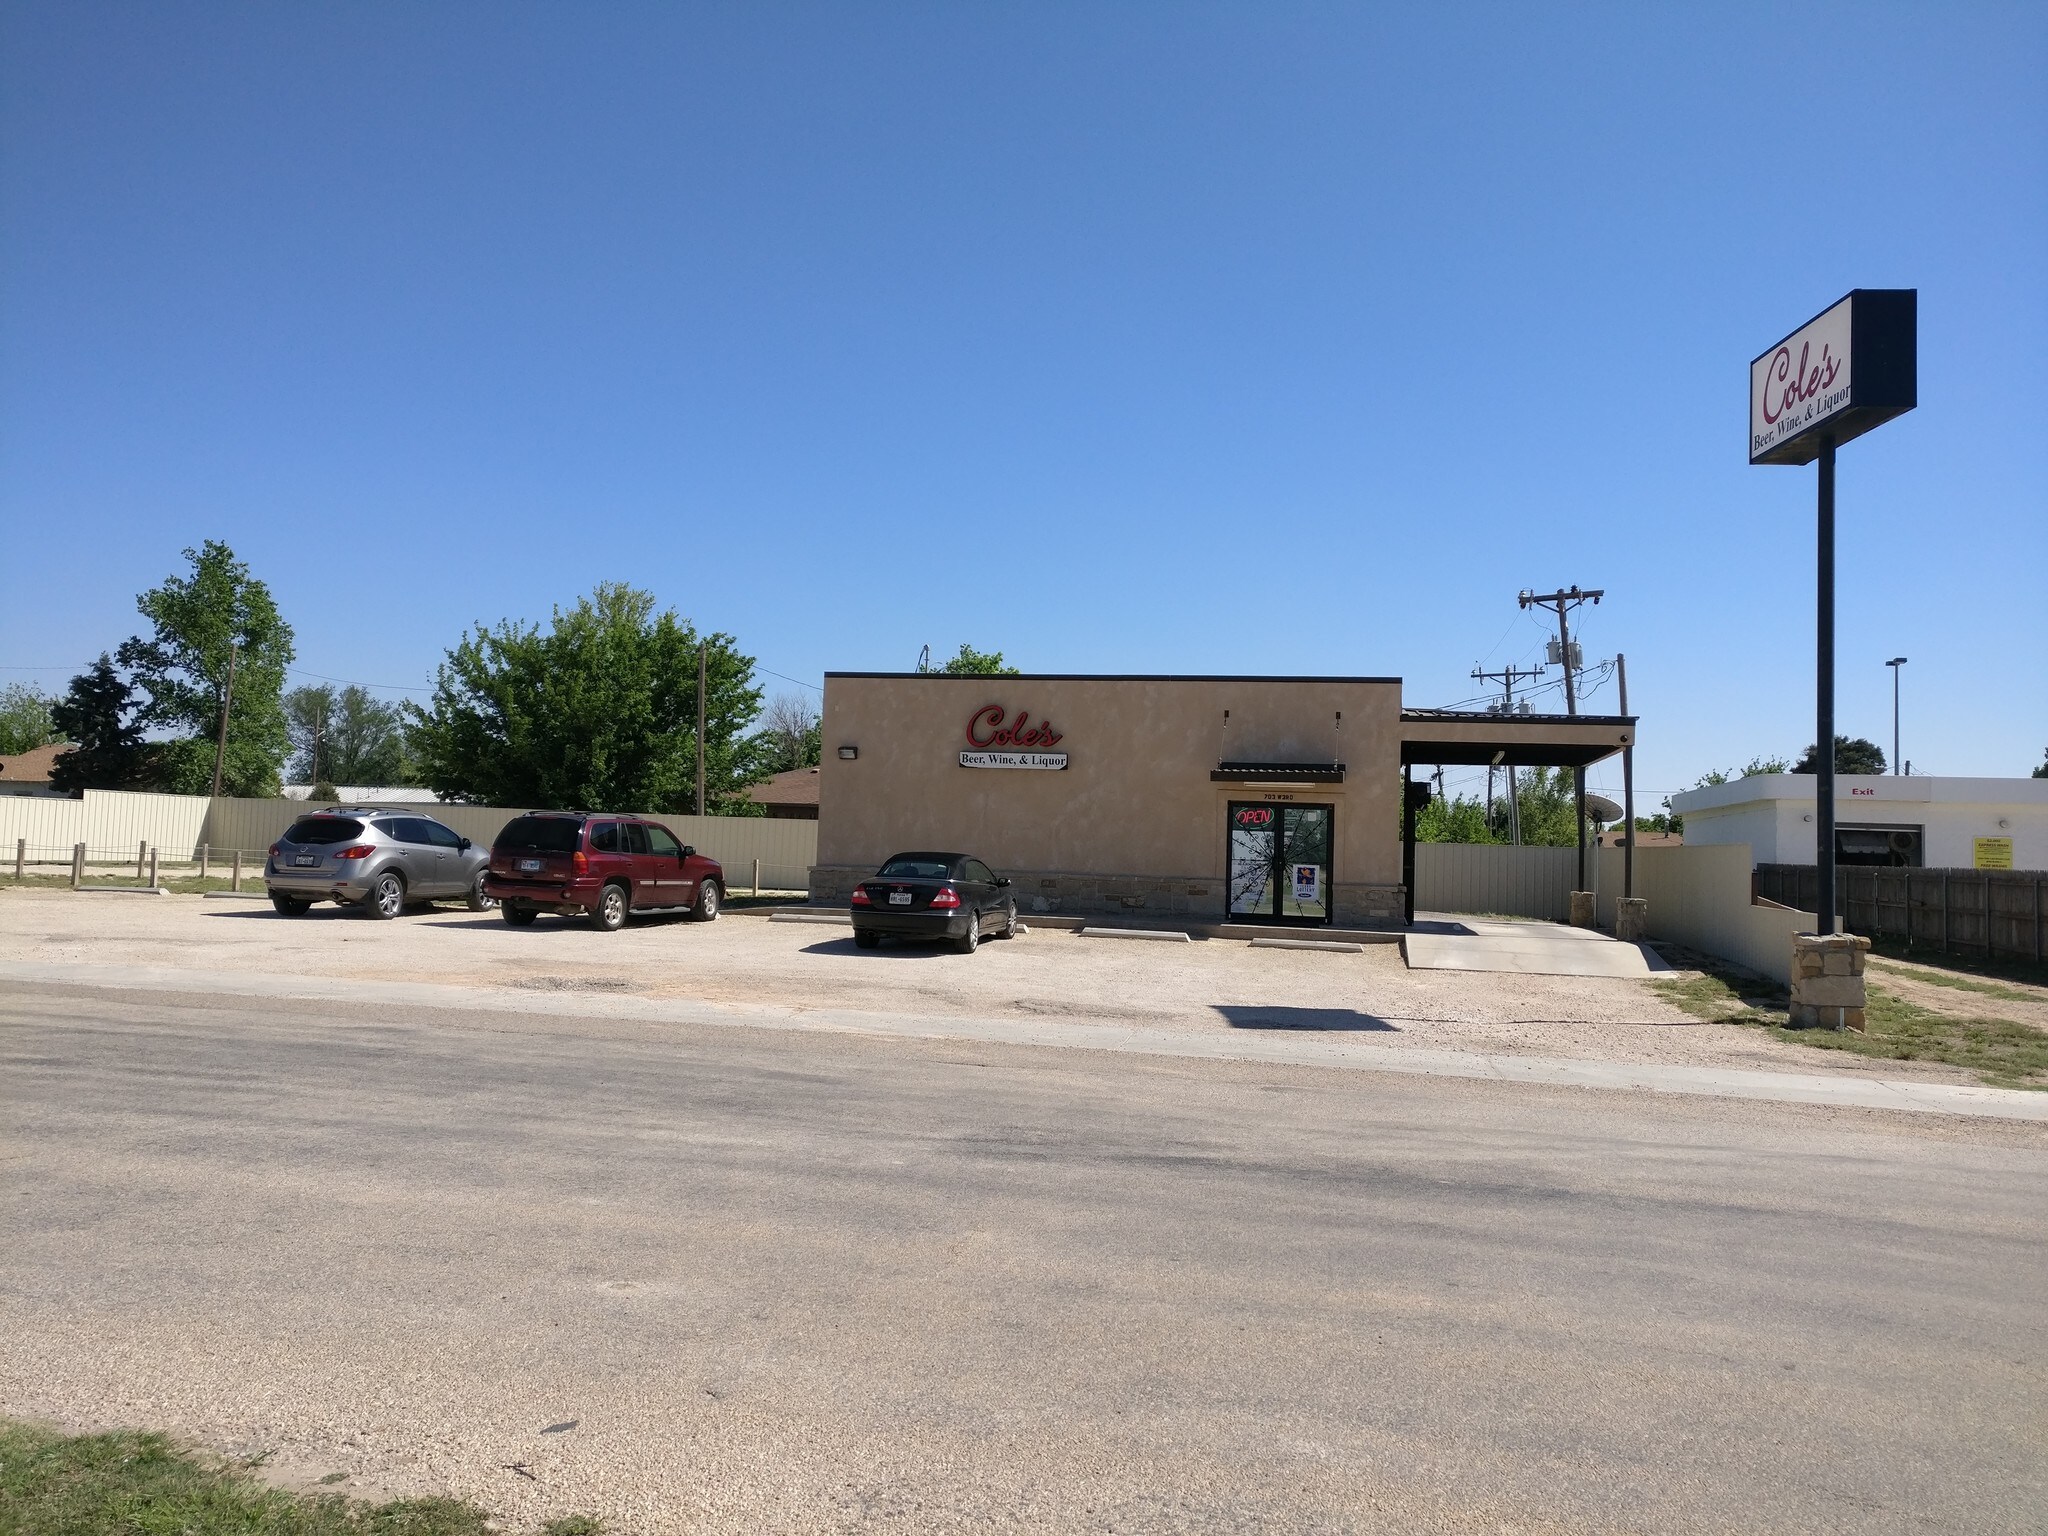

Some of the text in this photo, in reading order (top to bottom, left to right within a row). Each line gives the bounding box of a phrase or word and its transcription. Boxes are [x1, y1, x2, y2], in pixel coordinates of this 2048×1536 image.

[1763, 341, 1841, 425] Cole's
[1753, 384, 1851, 451] Beer, Wine, & Liquor
[966, 704, 1064, 748] Cole's
[961, 753, 1066, 767] Beer, Wine, & Liquor
[1851, 788, 1875, 796] Exit
[1236, 809, 1271, 824] OPEN
